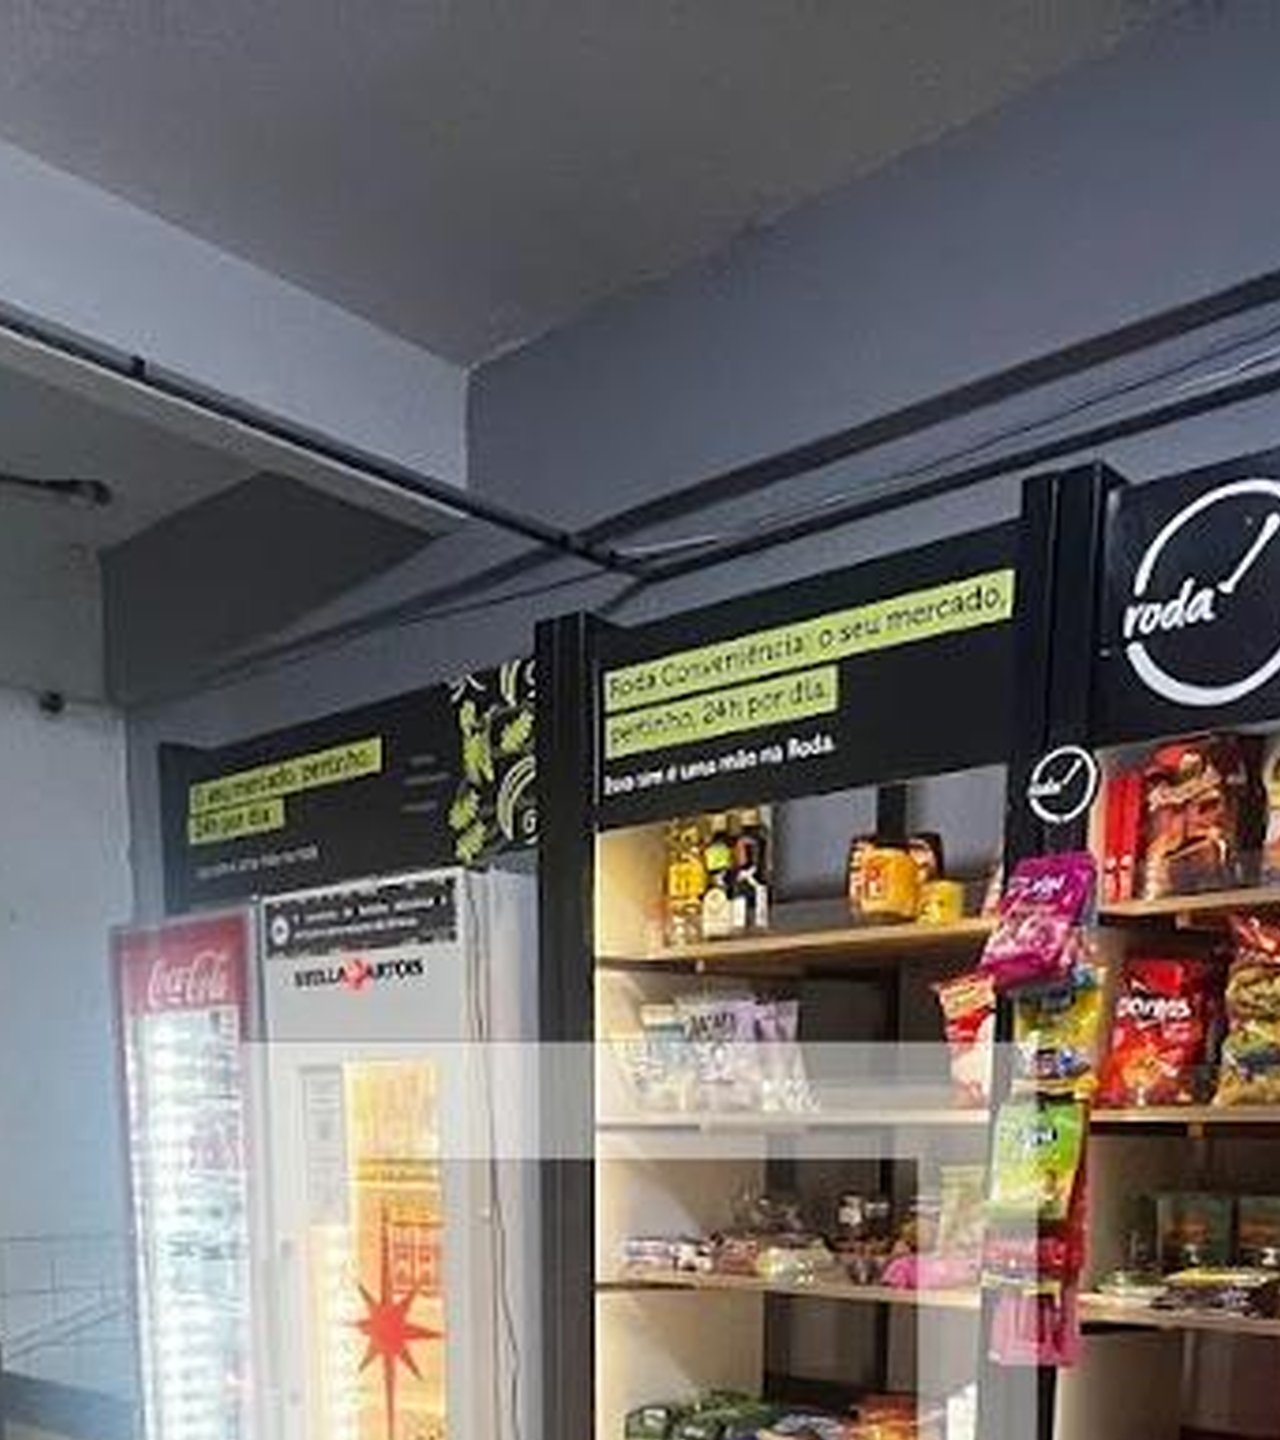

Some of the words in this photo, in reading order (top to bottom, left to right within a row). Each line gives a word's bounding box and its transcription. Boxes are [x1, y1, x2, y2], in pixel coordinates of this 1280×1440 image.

[1123, 577, 1217, 639] roda
[818, 629, 834, 650] o
[838, 617, 881, 643] seu
[747, 688, 785, 721] por
[759, 744, 784, 764] na
